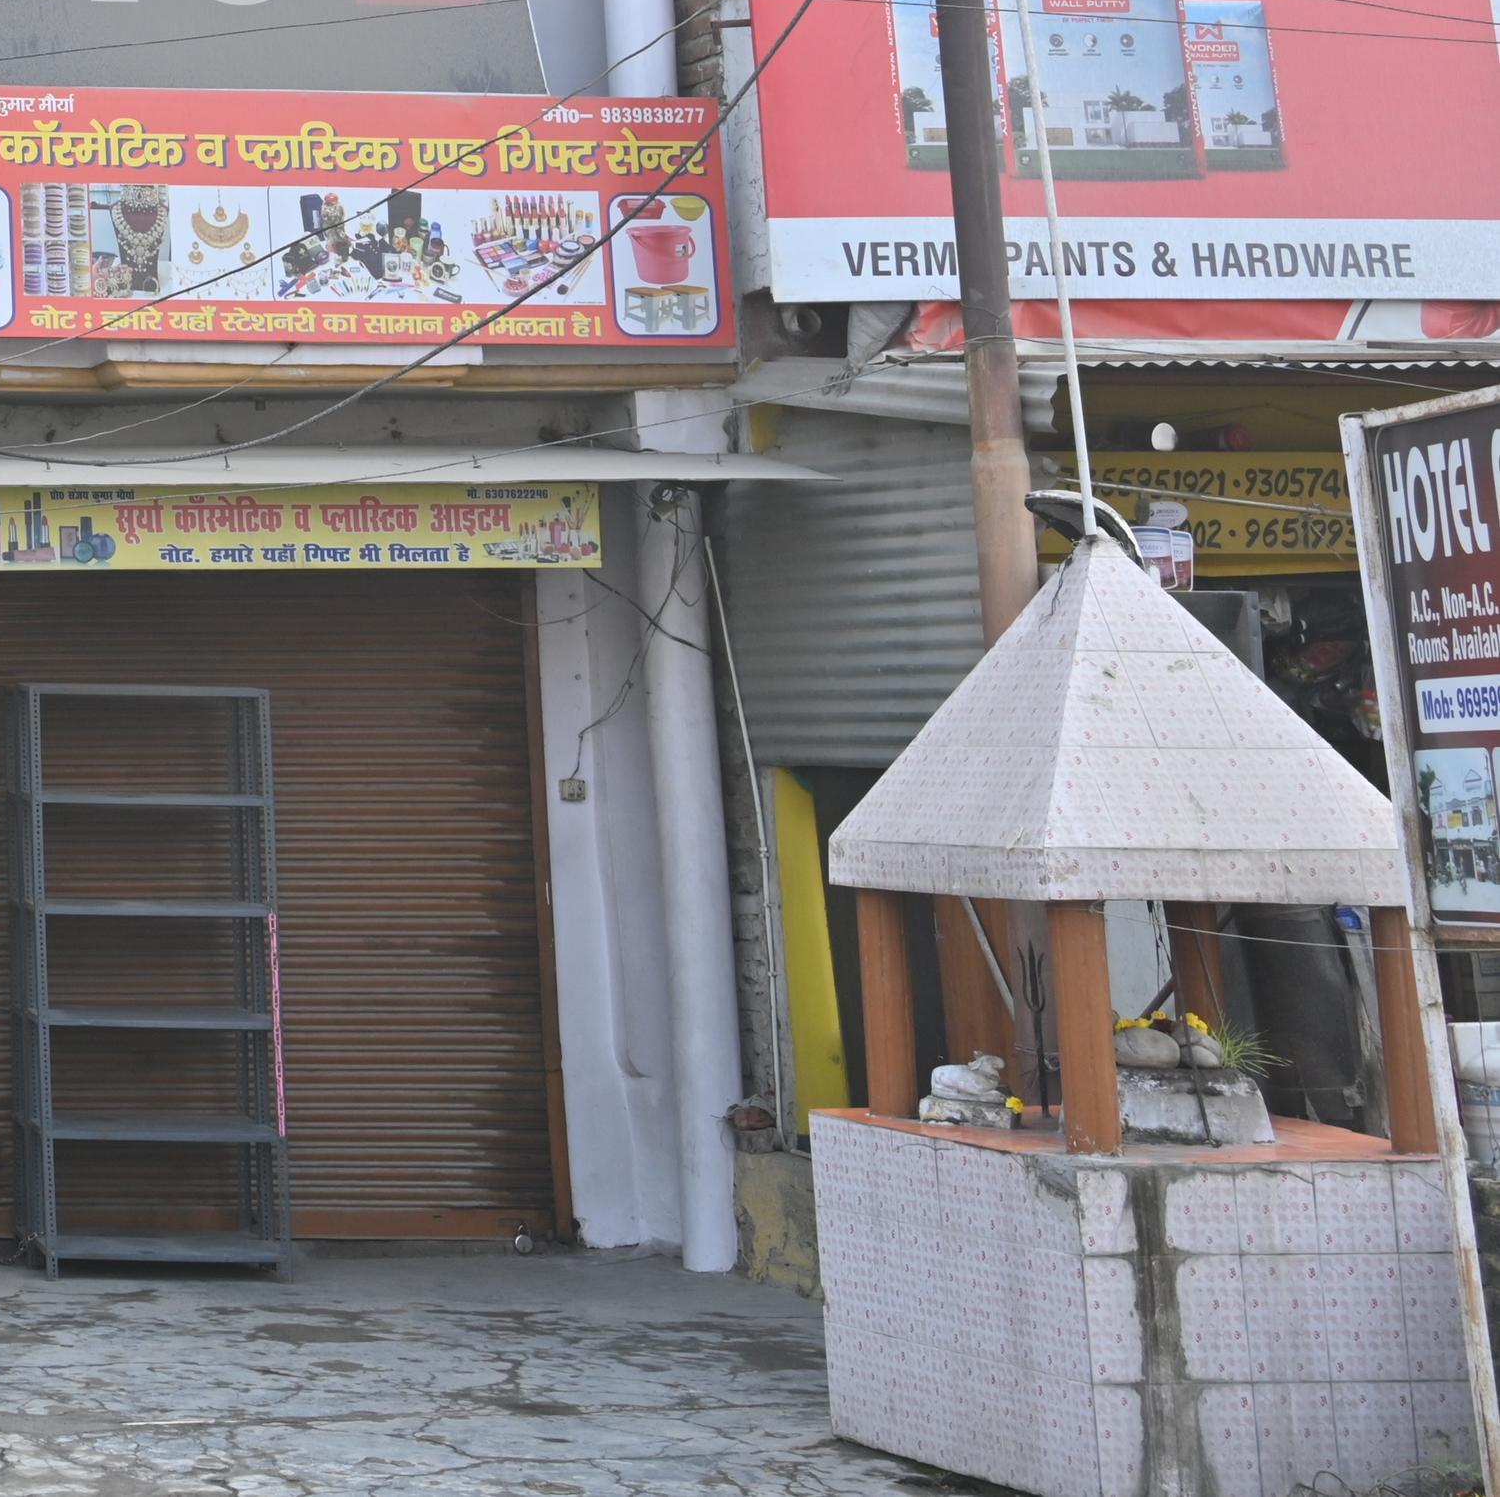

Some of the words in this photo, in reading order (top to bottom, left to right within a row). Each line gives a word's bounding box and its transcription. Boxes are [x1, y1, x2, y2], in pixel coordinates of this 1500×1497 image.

[1050, 0, 1082, 8] WALL
[1087, 0, 1126, 8] PUTTY
[601, 107, 704, 125] 9839838277
[196, 134, 225, 167] व
[235, 120, 401, 170] प्लास्टिक
[409, 138, 487, 175] एण्ड
[498, 125, 597, 174] गिफ्ट
[842, 243, 956, 278] VERM
[1151, 243, 1177, 278] &
[1193, 243, 1415, 278] HARDWARE
[1382, 438, 1490, 564] HOTEL
[292, 504, 311, 532] व
[431, 504, 511, 536] आइटम
